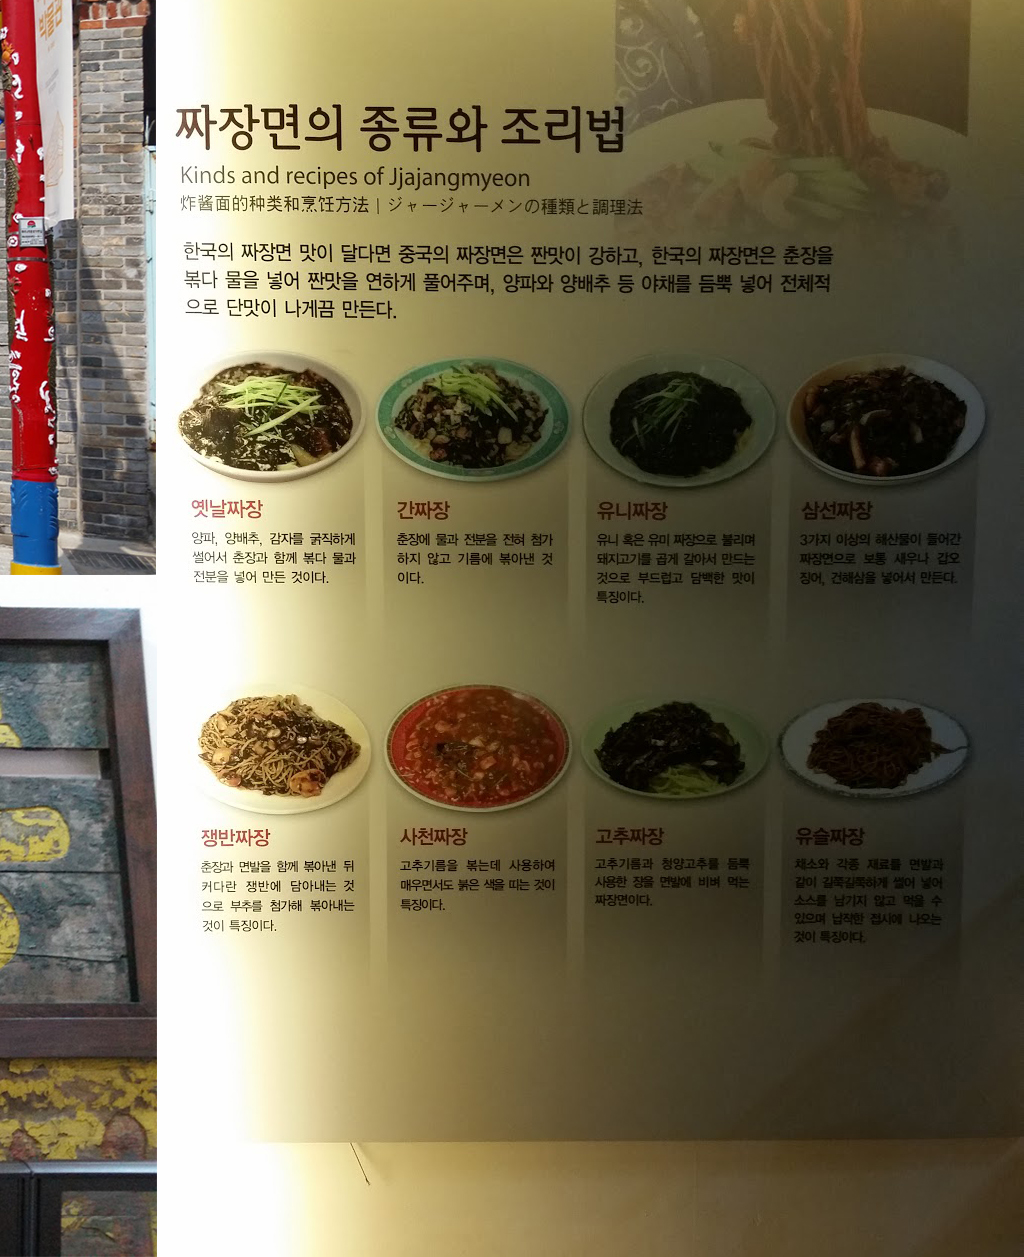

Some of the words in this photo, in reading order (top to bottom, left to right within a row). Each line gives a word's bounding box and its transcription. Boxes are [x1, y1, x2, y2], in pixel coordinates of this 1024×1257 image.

[176, 104, 341, 151] 짜장면의
[360, 105, 487, 152] 종류와
[501, 106, 623, 153] 조리법
[182, 165, 235, 183] Kinds
[242, 166, 278, 184] and
[287, 167, 357, 189] recipes
[364, 166, 384, 185] of
[389, 168, 529, 191] Jjajangmyeon
[181, 195, 368, 212] 炸酱面的种类和烹饪方法
[389, 197, 642, 215] ジャージャーメンの種類と調理法
[185, 242, 233, 261] 한국의
[242, 243, 290, 261] 짜장면
[300, 244, 332, 262] 맛이
[342, 244, 390, 263] 달다면
[399, 245, 448, 264] 중국의
[457, 246, 523, 264] 짜장면은
[531, 246, 580, 265] 짠맛이
[589, 246, 642, 266] 강하고,
[652, 246, 701, 265] 한국의
[709, 246, 775, 265] 짜장면은
[783, 246, 833, 265] 춘장을
[186, 271, 215, 288] 볶다
[227, 271, 257, 289] 물을
[268, 272, 299, 289] 넣어
[308, 272, 358, 290] 짠맛을
[366, 273, 415, 291] 연하게
[424, 274, 494, 295] 풀어주며,
[503, 274, 553, 293] 양파와
[561, 274, 609, 293] 양배추
[618, 275, 634, 293] 등
[642, 275, 691, 293] 야채를
[699, 275, 731, 293] 듬뿍
[741, 274, 772, 293] 넣어
[781, 274, 830, 292] 전체적
[187, 300, 217, 314] 으로
[228, 299, 276, 317] 단맛이
[286, 300, 334, 318] 나게끔
[343, 300, 396, 319] 만든다.
[192, 500, 263, 518] 옛날짜장
[398, 501, 450, 520] 간짜장
[597, 502, 668, 520] 유니짜장
[398, 533, 430, 546] 춘장에
[436, 534, 457, 546] 물과
[464, 533, 496, 546] 전분을
[504, 534, 524, 546] 전혀
[531, 534, 552, 546] 첨가
[398, 572, 424, 584] 이다.
[202, 829, 270, 847] 쟁반짜장
[401, 828, 467, 846] 사천짜장
[402, 860, 457, 871] 고추기름을
[468, 860, 500, 871] 볶는데
[510, 859, 554, 871] 사용하여
